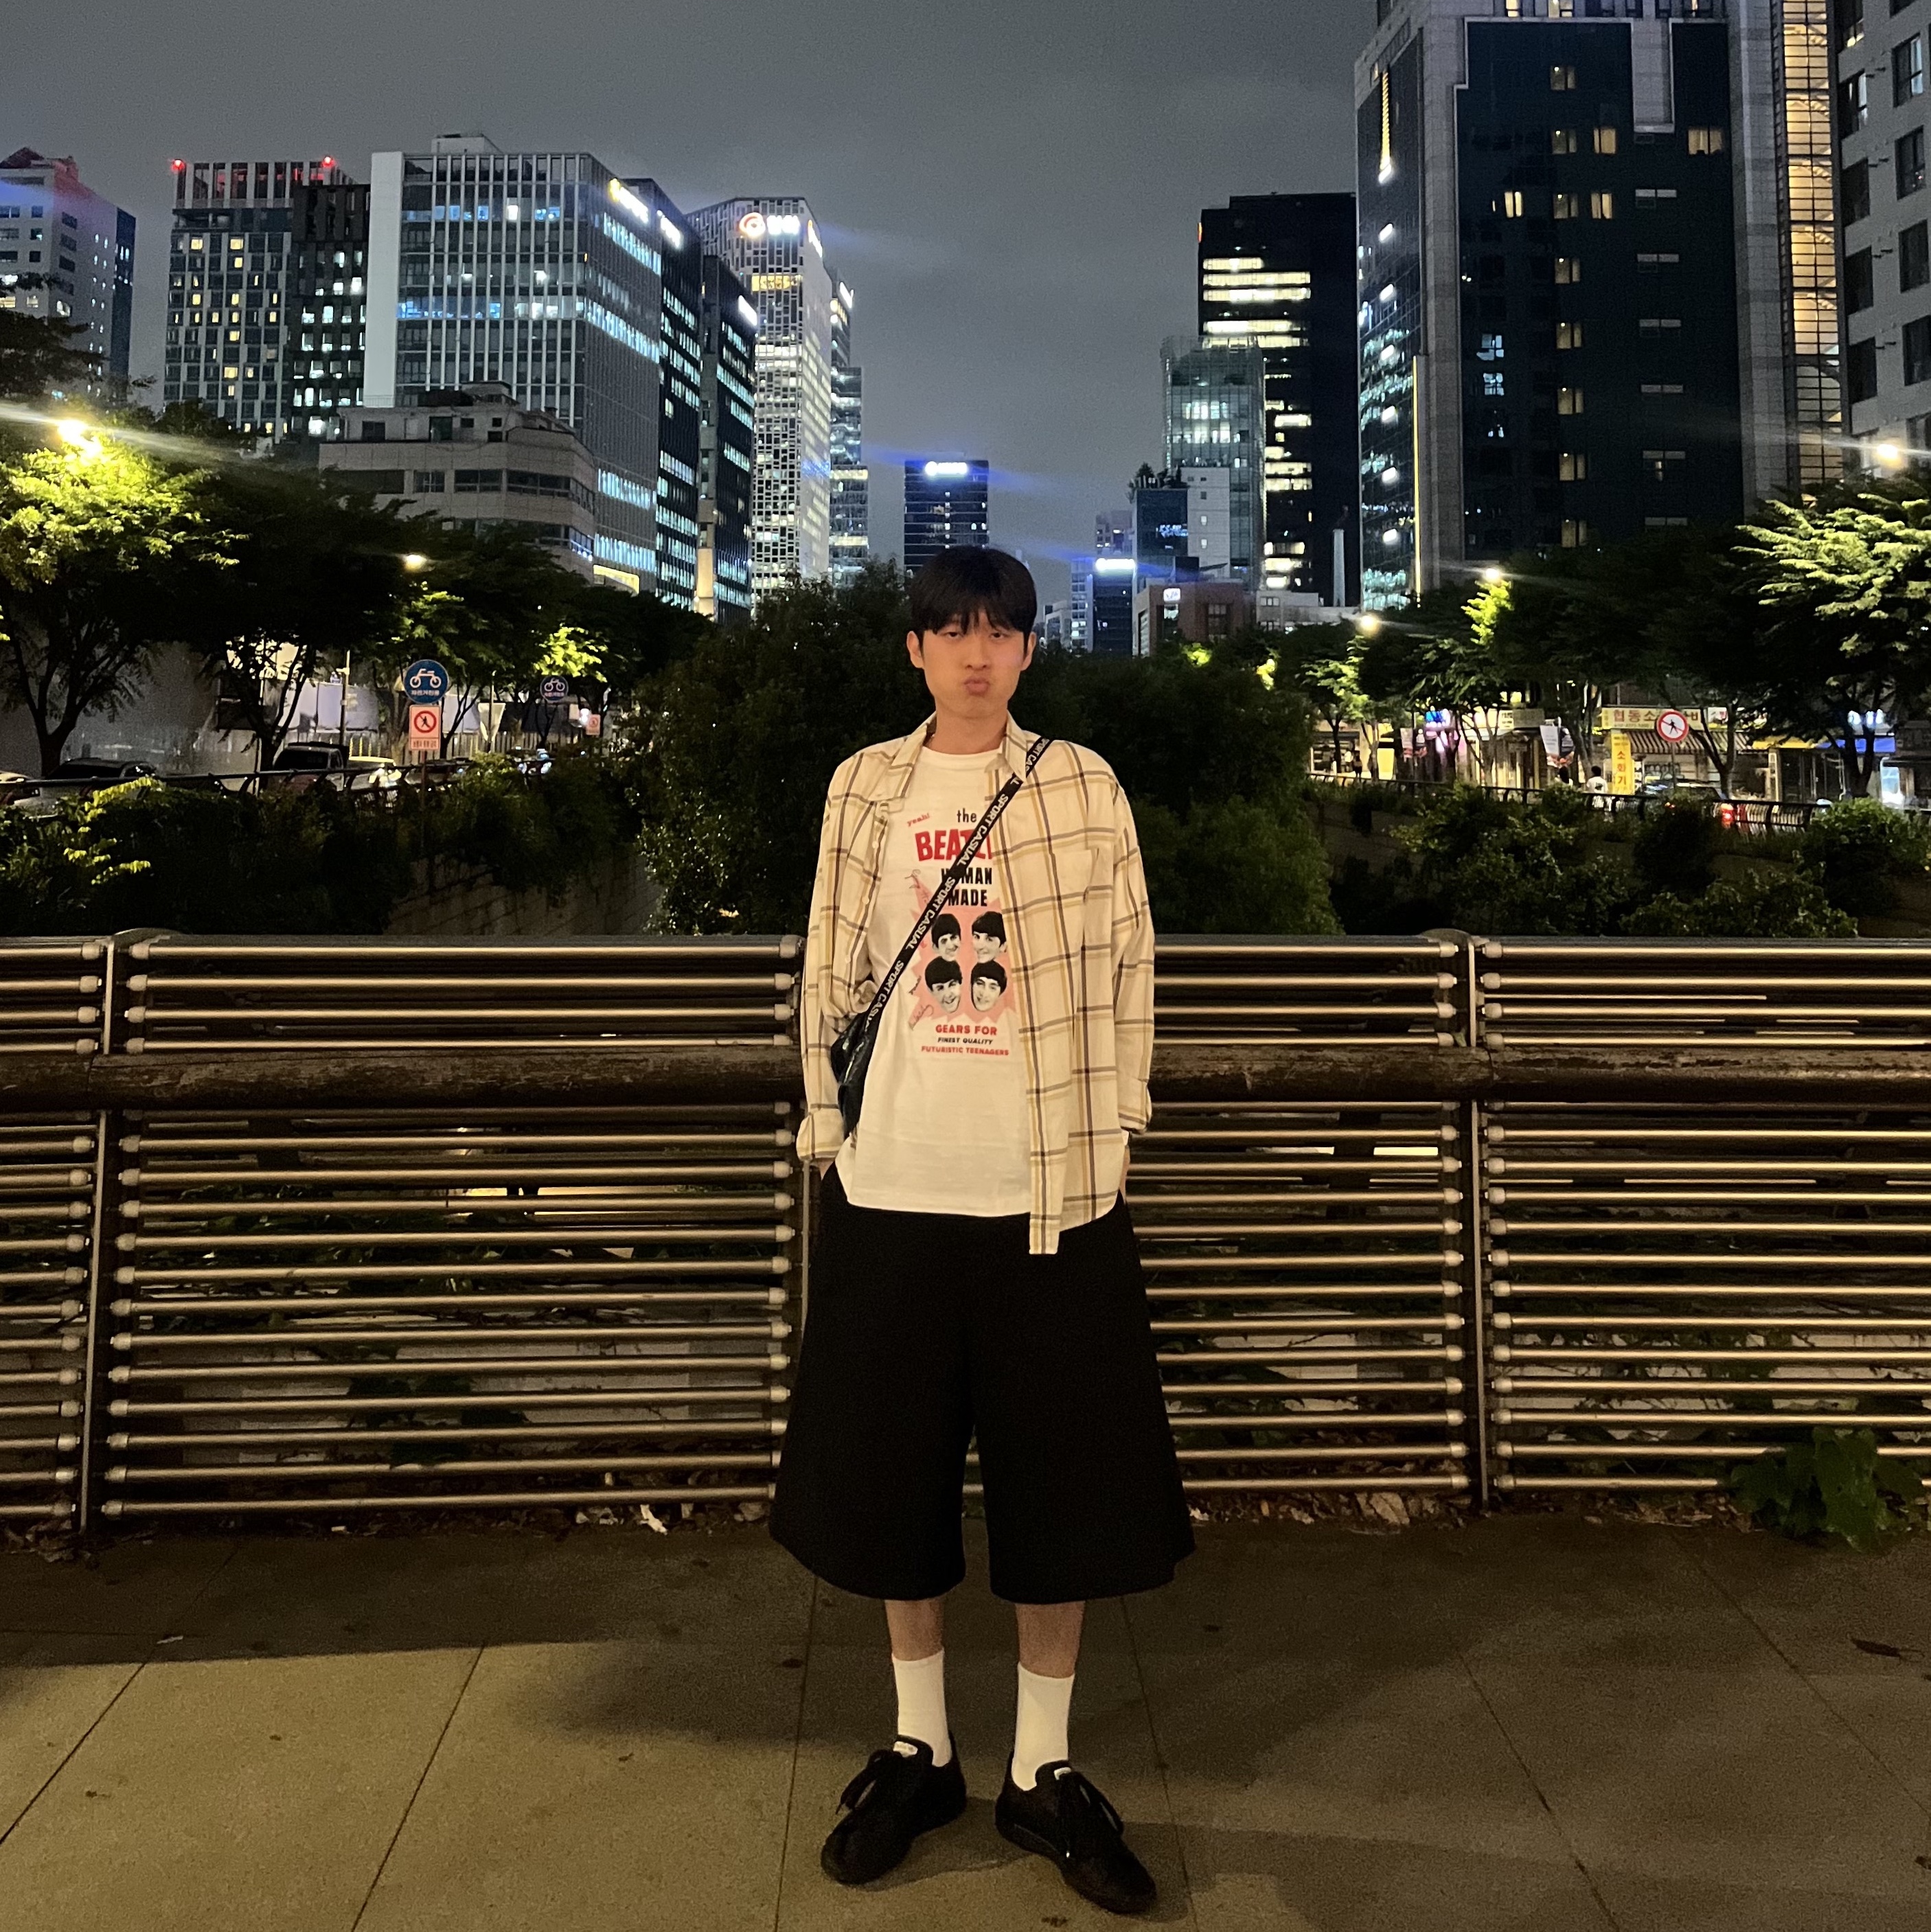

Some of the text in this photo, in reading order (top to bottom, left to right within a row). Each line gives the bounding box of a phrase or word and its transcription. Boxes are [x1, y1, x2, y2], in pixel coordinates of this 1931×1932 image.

[957, 807, 977, 823] the
[957, 794, 1009, 866] SPORT CASUAL
[931, 876, 955, 912] SPORT
[948, 889, 987, 906] MADE
[905, 909, 935, 950] CASUAL
[883, 960, 904, 995] SPORT
[935, 1024, 997, 1035] GEARS FOR
[966, 1047, 1009, 1056] TEENAGERS
